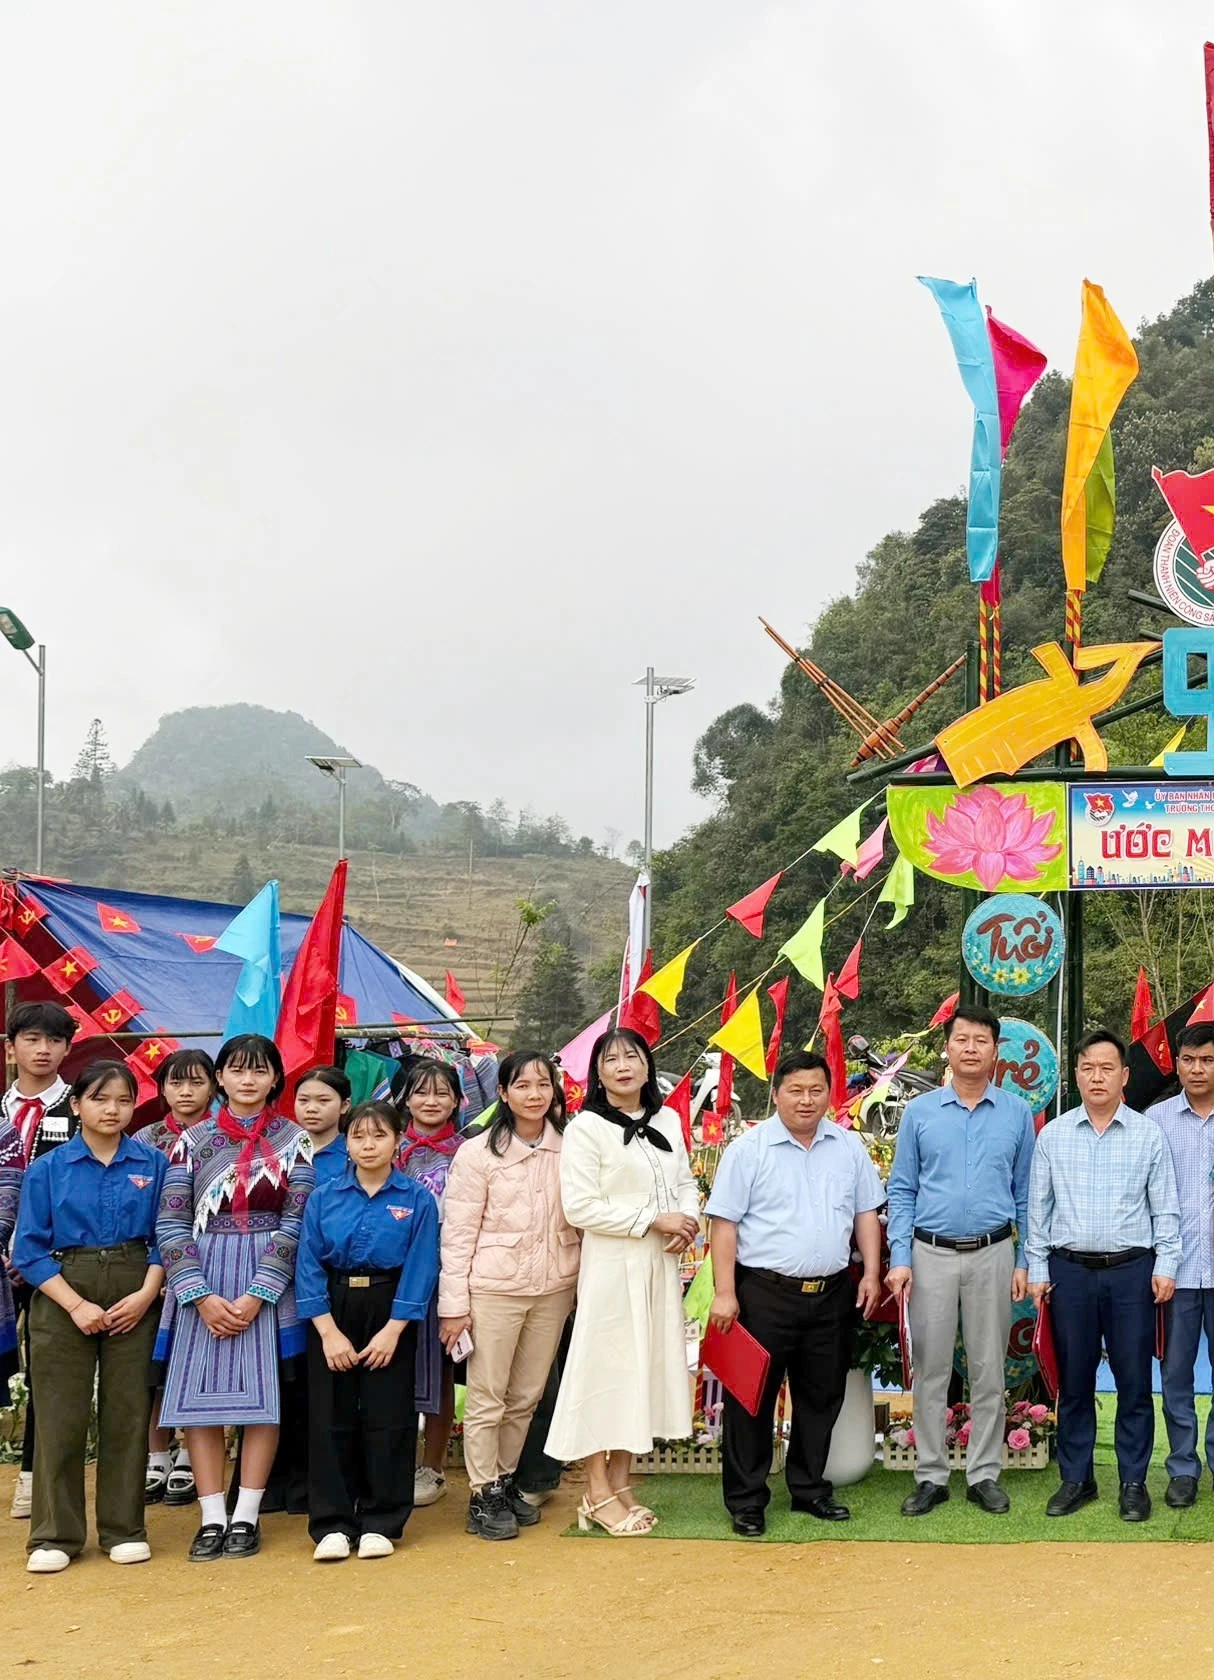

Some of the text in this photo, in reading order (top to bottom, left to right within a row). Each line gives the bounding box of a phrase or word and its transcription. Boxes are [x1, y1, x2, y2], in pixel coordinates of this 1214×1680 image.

[1154, 789, 1167, 801] ỦY
[1168, 792, 1186, 801] BAN
[1187, 789, 1210, 800] NHÂN
[1164, 802, 1198, 813] TRƯỜNG
[1101, 822, 1171, 859] ƯỚC
[976, 911, 1054, 966] Tuổi
